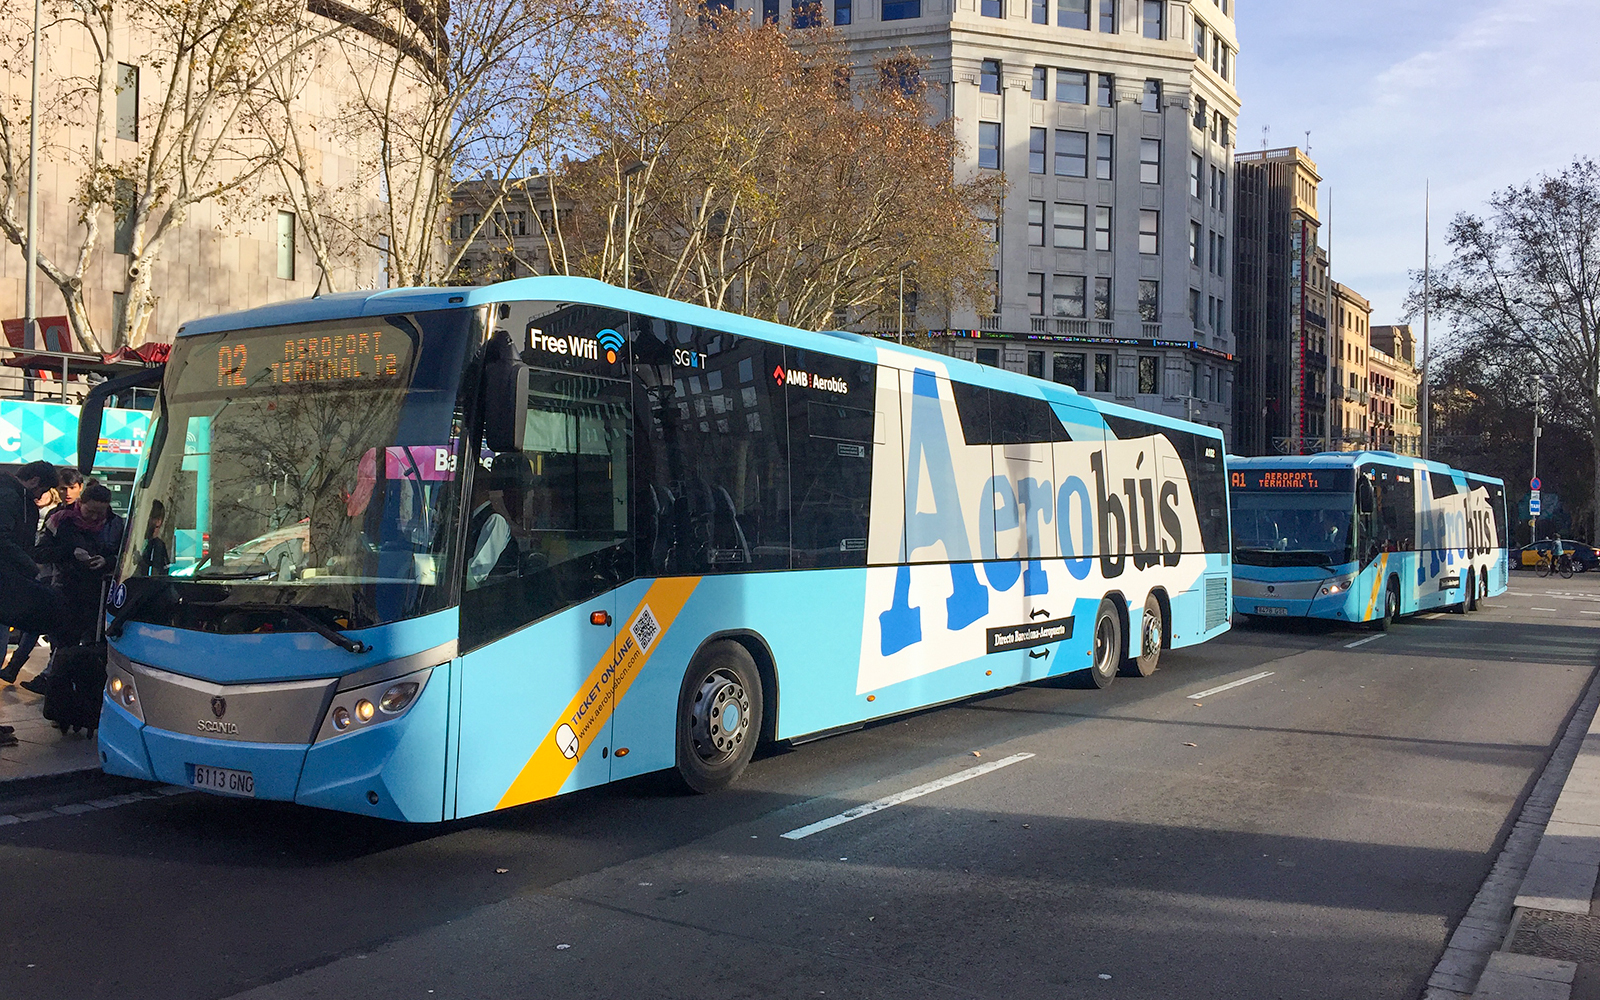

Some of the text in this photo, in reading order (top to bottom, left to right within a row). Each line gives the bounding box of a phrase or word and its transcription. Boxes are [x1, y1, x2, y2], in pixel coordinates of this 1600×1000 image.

[285, 331, 382, 360] AEROPORT
[530, 328, 599, 360] Free Wifi
[217, 344, 248, 387] A2
[271, 353, 397, 383] TERMINAL T2
[786, 369, 848, 394] AMB Aerobús
[1231, 472, 1247, 487] A1
[1258, 479, 1319, 488] TERMINAL T1
[1264, 472, 1313, 480] AEROPORT
[878, 367, 1183, 657] Aerobús
[1417, 469, 1492, 586] Aerobús
[994, 633, 1014, 647] Directo
[570, 636, 635, 726] TICKET ON-LINE
[578, 650, 641, 739] www.aerobusbcn.com
[197, 719, 240, 735] SCANIA
[196, 767, 254, 793] 6113 GNG
